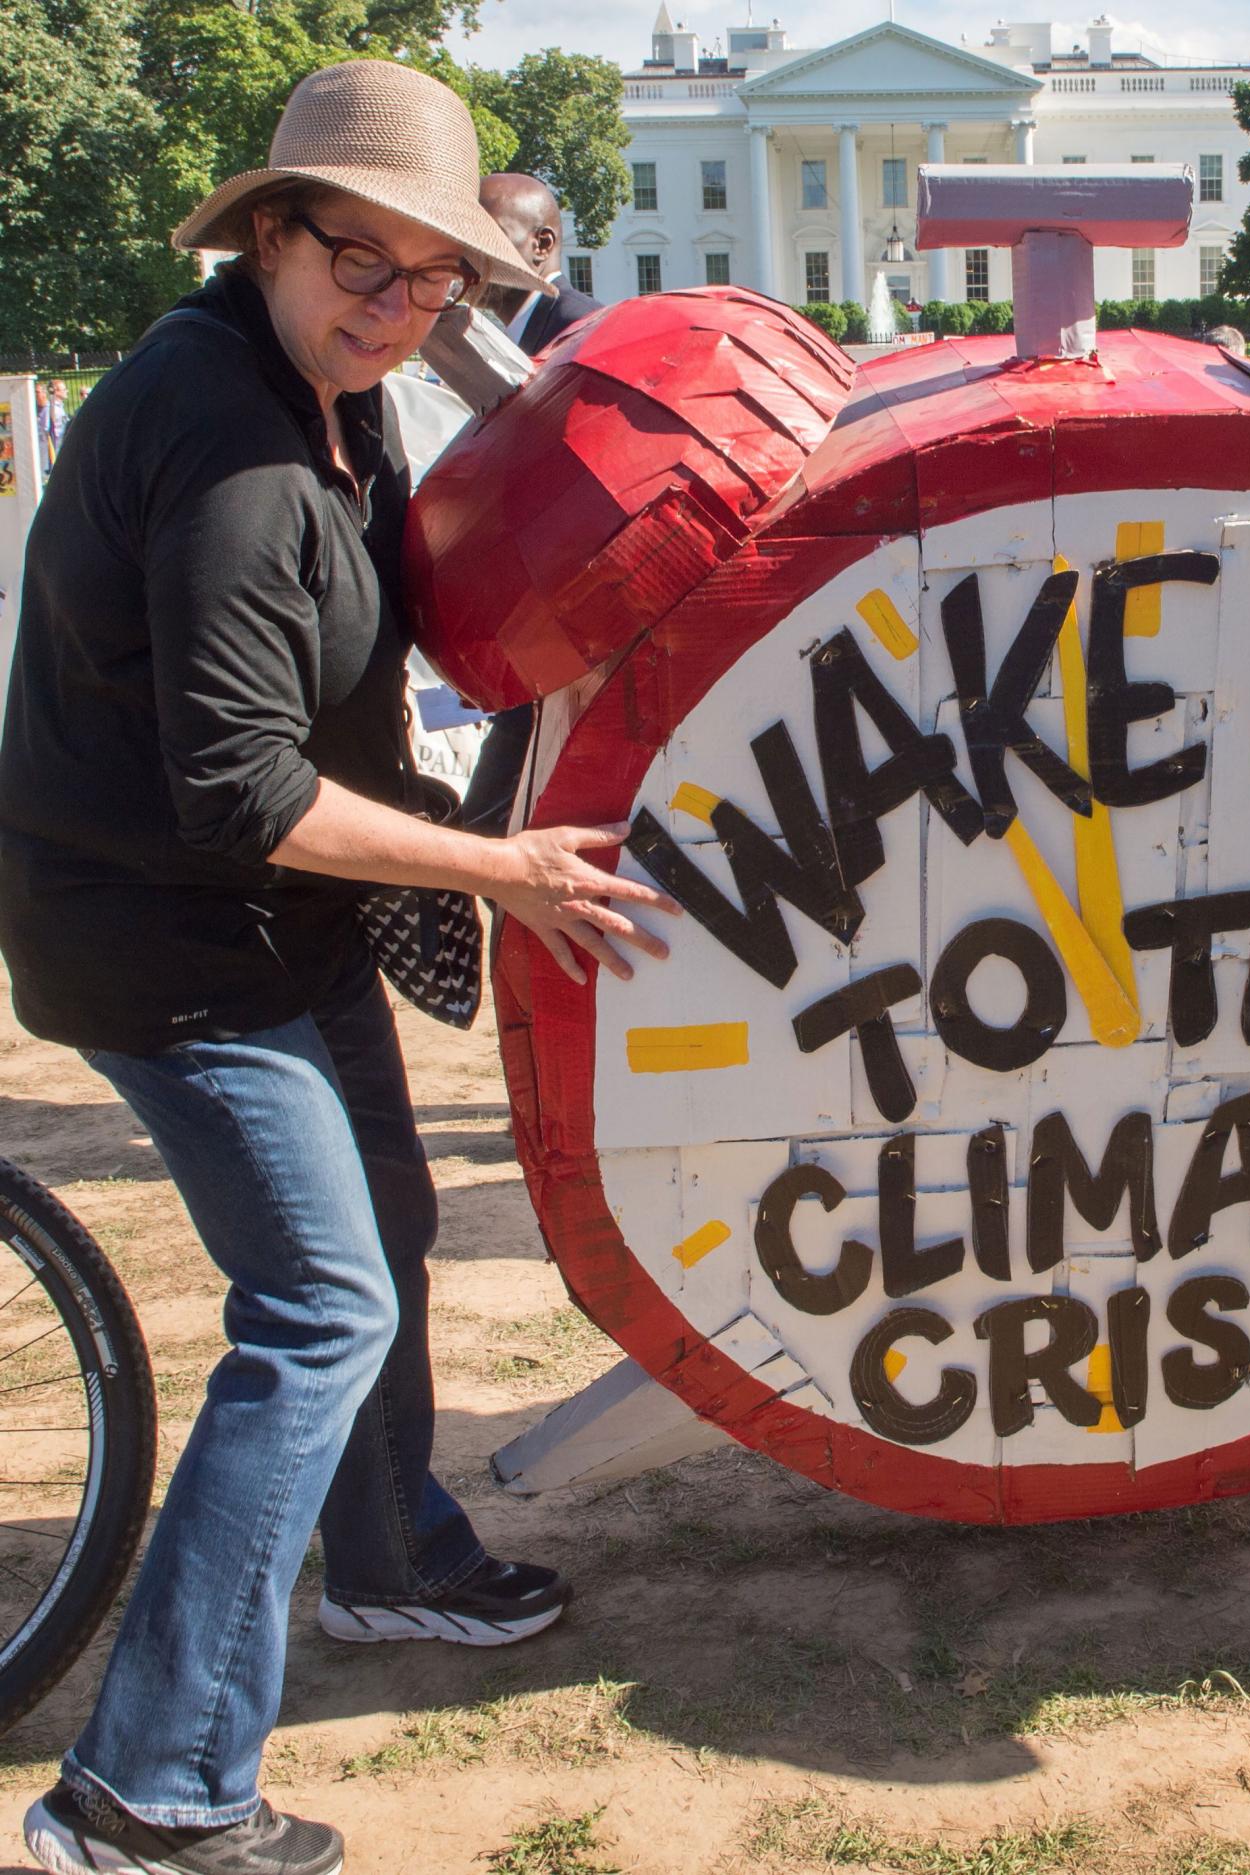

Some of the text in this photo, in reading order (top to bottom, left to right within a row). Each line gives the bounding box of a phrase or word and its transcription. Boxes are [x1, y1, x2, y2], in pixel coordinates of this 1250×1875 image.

[627, 550, 1219, 990] WAKE
[172, 1009, 209, 1024] DRI-FIT
[791, 917, 1067, 1121] TO
